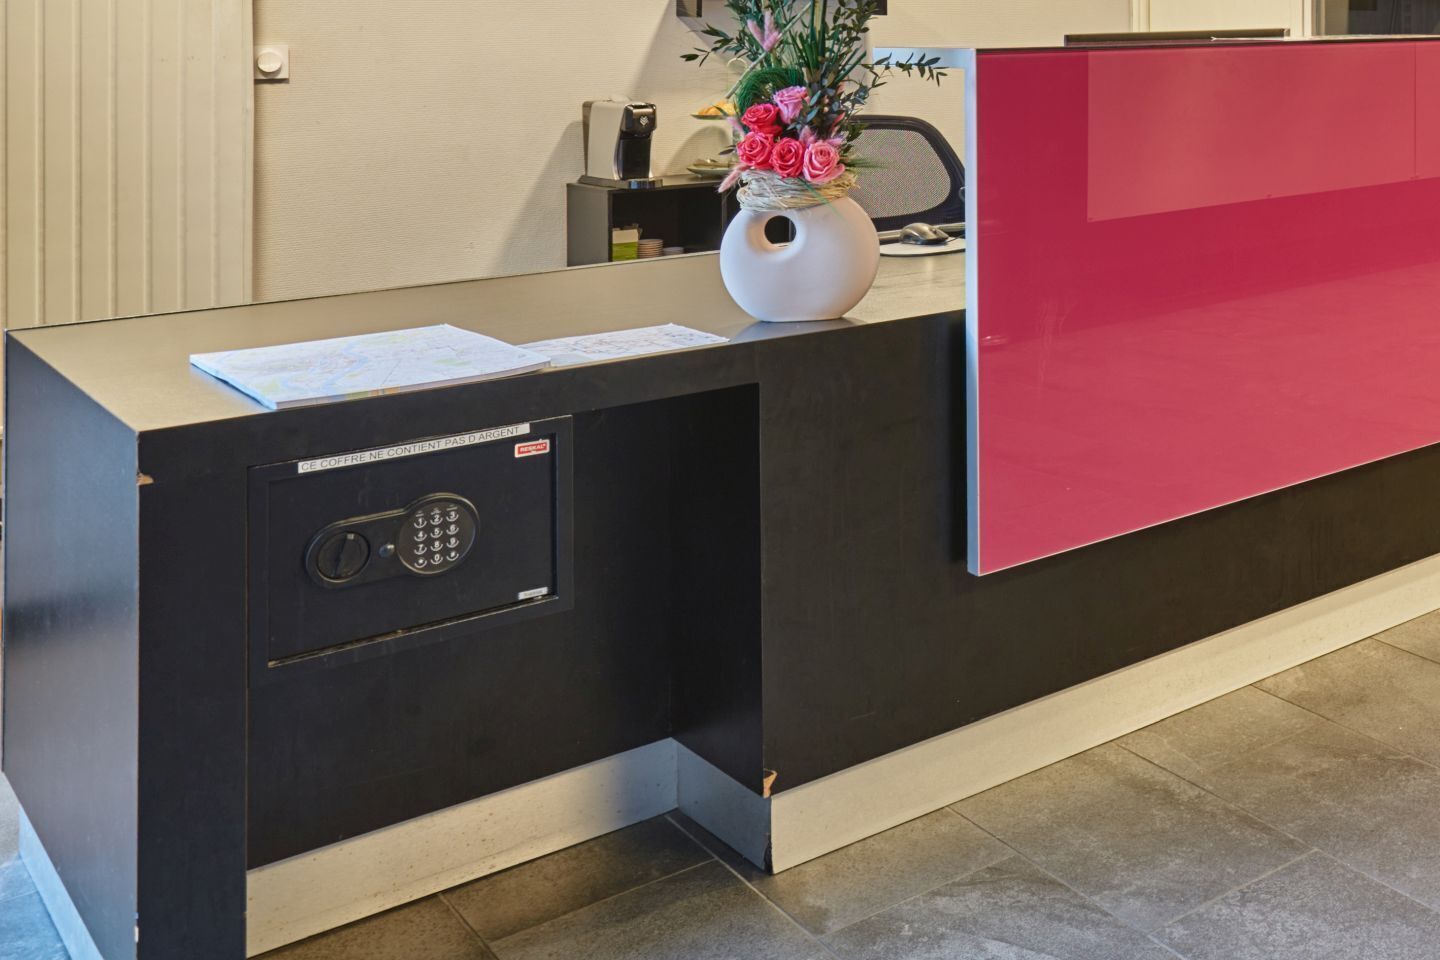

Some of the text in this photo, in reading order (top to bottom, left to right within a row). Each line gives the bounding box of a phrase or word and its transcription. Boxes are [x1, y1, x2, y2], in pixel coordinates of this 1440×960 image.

[301, 462, 317, 471] CE
[320, 453, 366, 468] COFFRE
[369, 449, 384, 460] NE
[387, 440, 442, 457] CONTIENT
[444, 436, 466, 447] PAS
[479, 426, 520, 441] ARGENT
[450, 511, 456, 519] 3
[450, 537, 456, 545] 9
